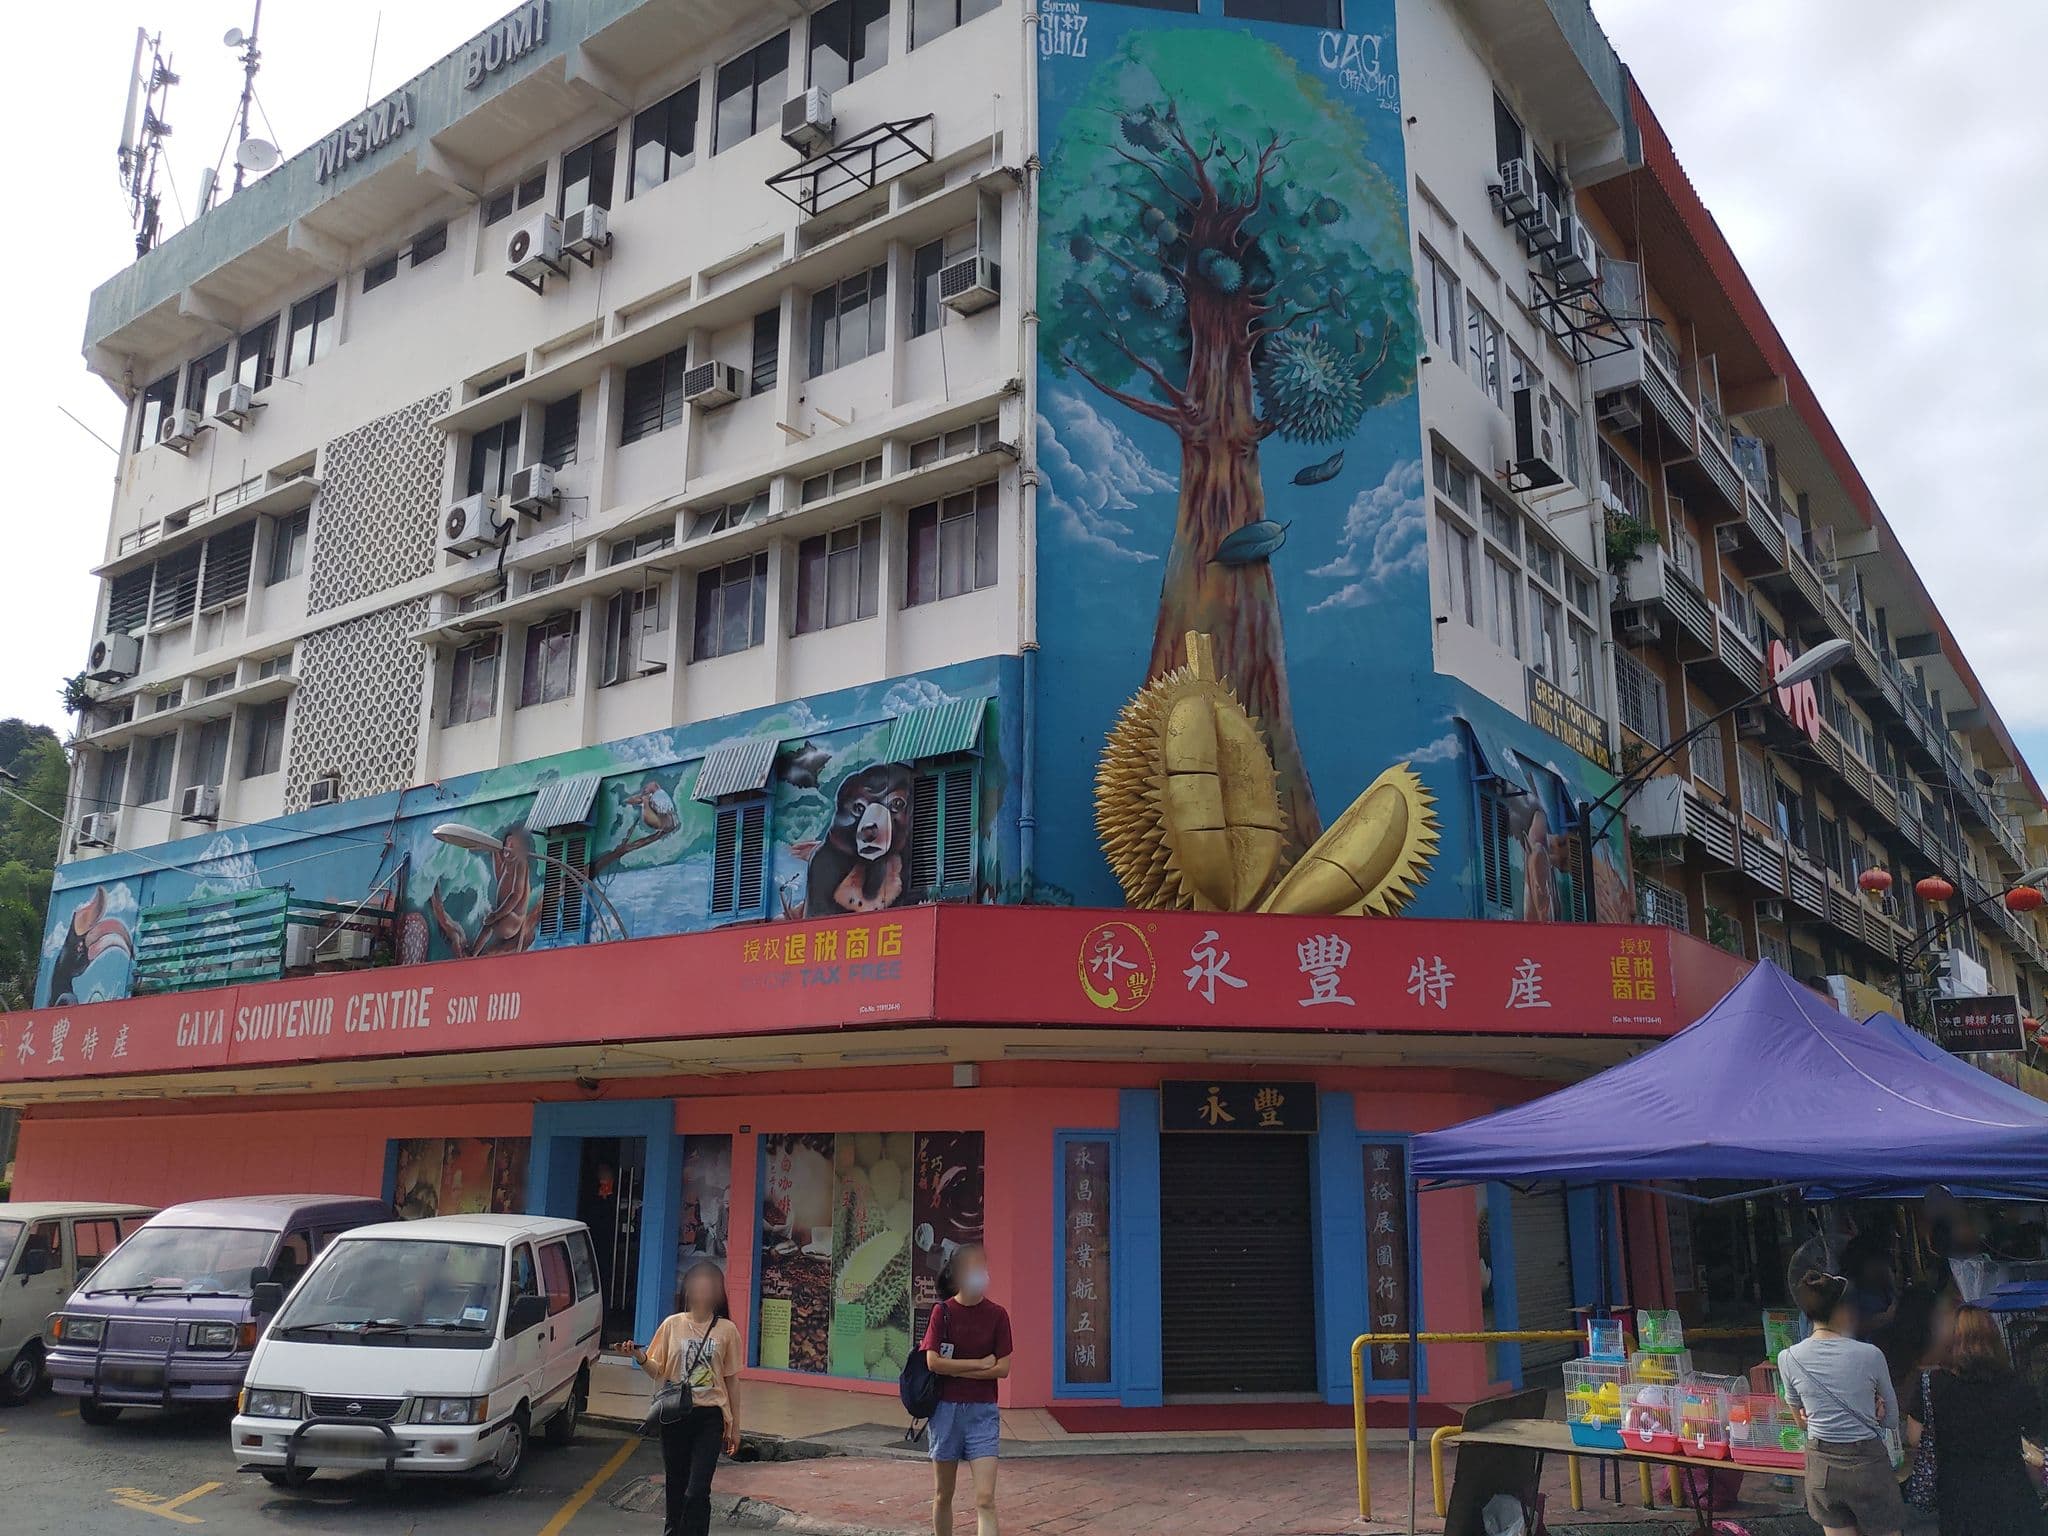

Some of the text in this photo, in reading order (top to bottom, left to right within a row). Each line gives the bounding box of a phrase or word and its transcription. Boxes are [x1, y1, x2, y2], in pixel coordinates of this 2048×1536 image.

[315, 0, 549, 185] WISMA BUMI
[1531, 700, 1553, 735] TOURS
[1559, 718, 1583, 754] TRAVEL
[1535, 678, 1602, 742] GREAT FORTUNE
[1620, 938, 1652, 954] 授权
[801, 965, 842, 988] TAX
[848, 960, 903, 983] FREE
[1610, 956, 1655, 978] 退税
[1612, 979, 1656, 1000] 商店
[176, 987, 521, 1048] GAYA SOUVENIR CENTRE SDN BHD
[1198, 1086, 1285, 1128] 永豐
[149, 1335, 182, 1344] TOYOA
